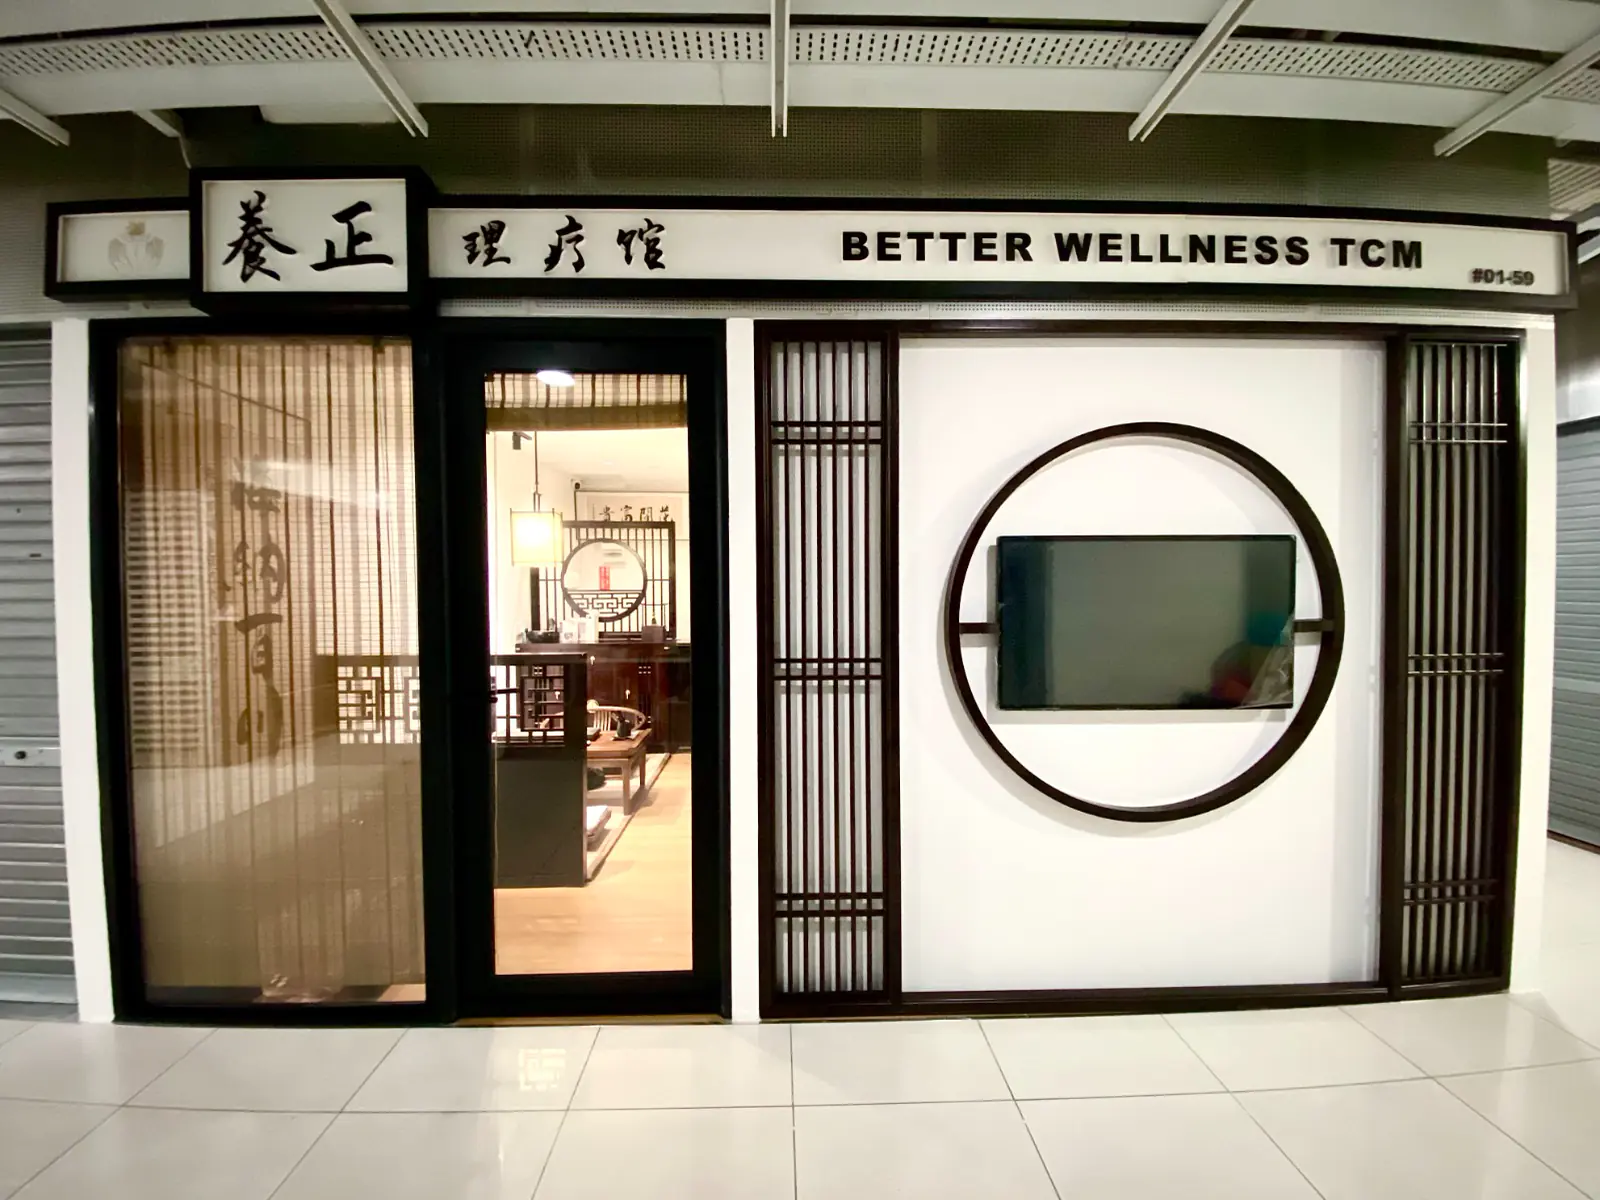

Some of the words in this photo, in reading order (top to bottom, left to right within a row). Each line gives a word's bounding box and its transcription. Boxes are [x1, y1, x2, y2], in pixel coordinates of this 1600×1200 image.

[461, 214, 666, 274] 理疗馆
[842, 231, 1033, 262] BETTER
[1054, 233, 1309, 266] WELLNESS
[1330, 238, 1423, 269] TCM
[1471, 267, 1535, 286] #01-59
